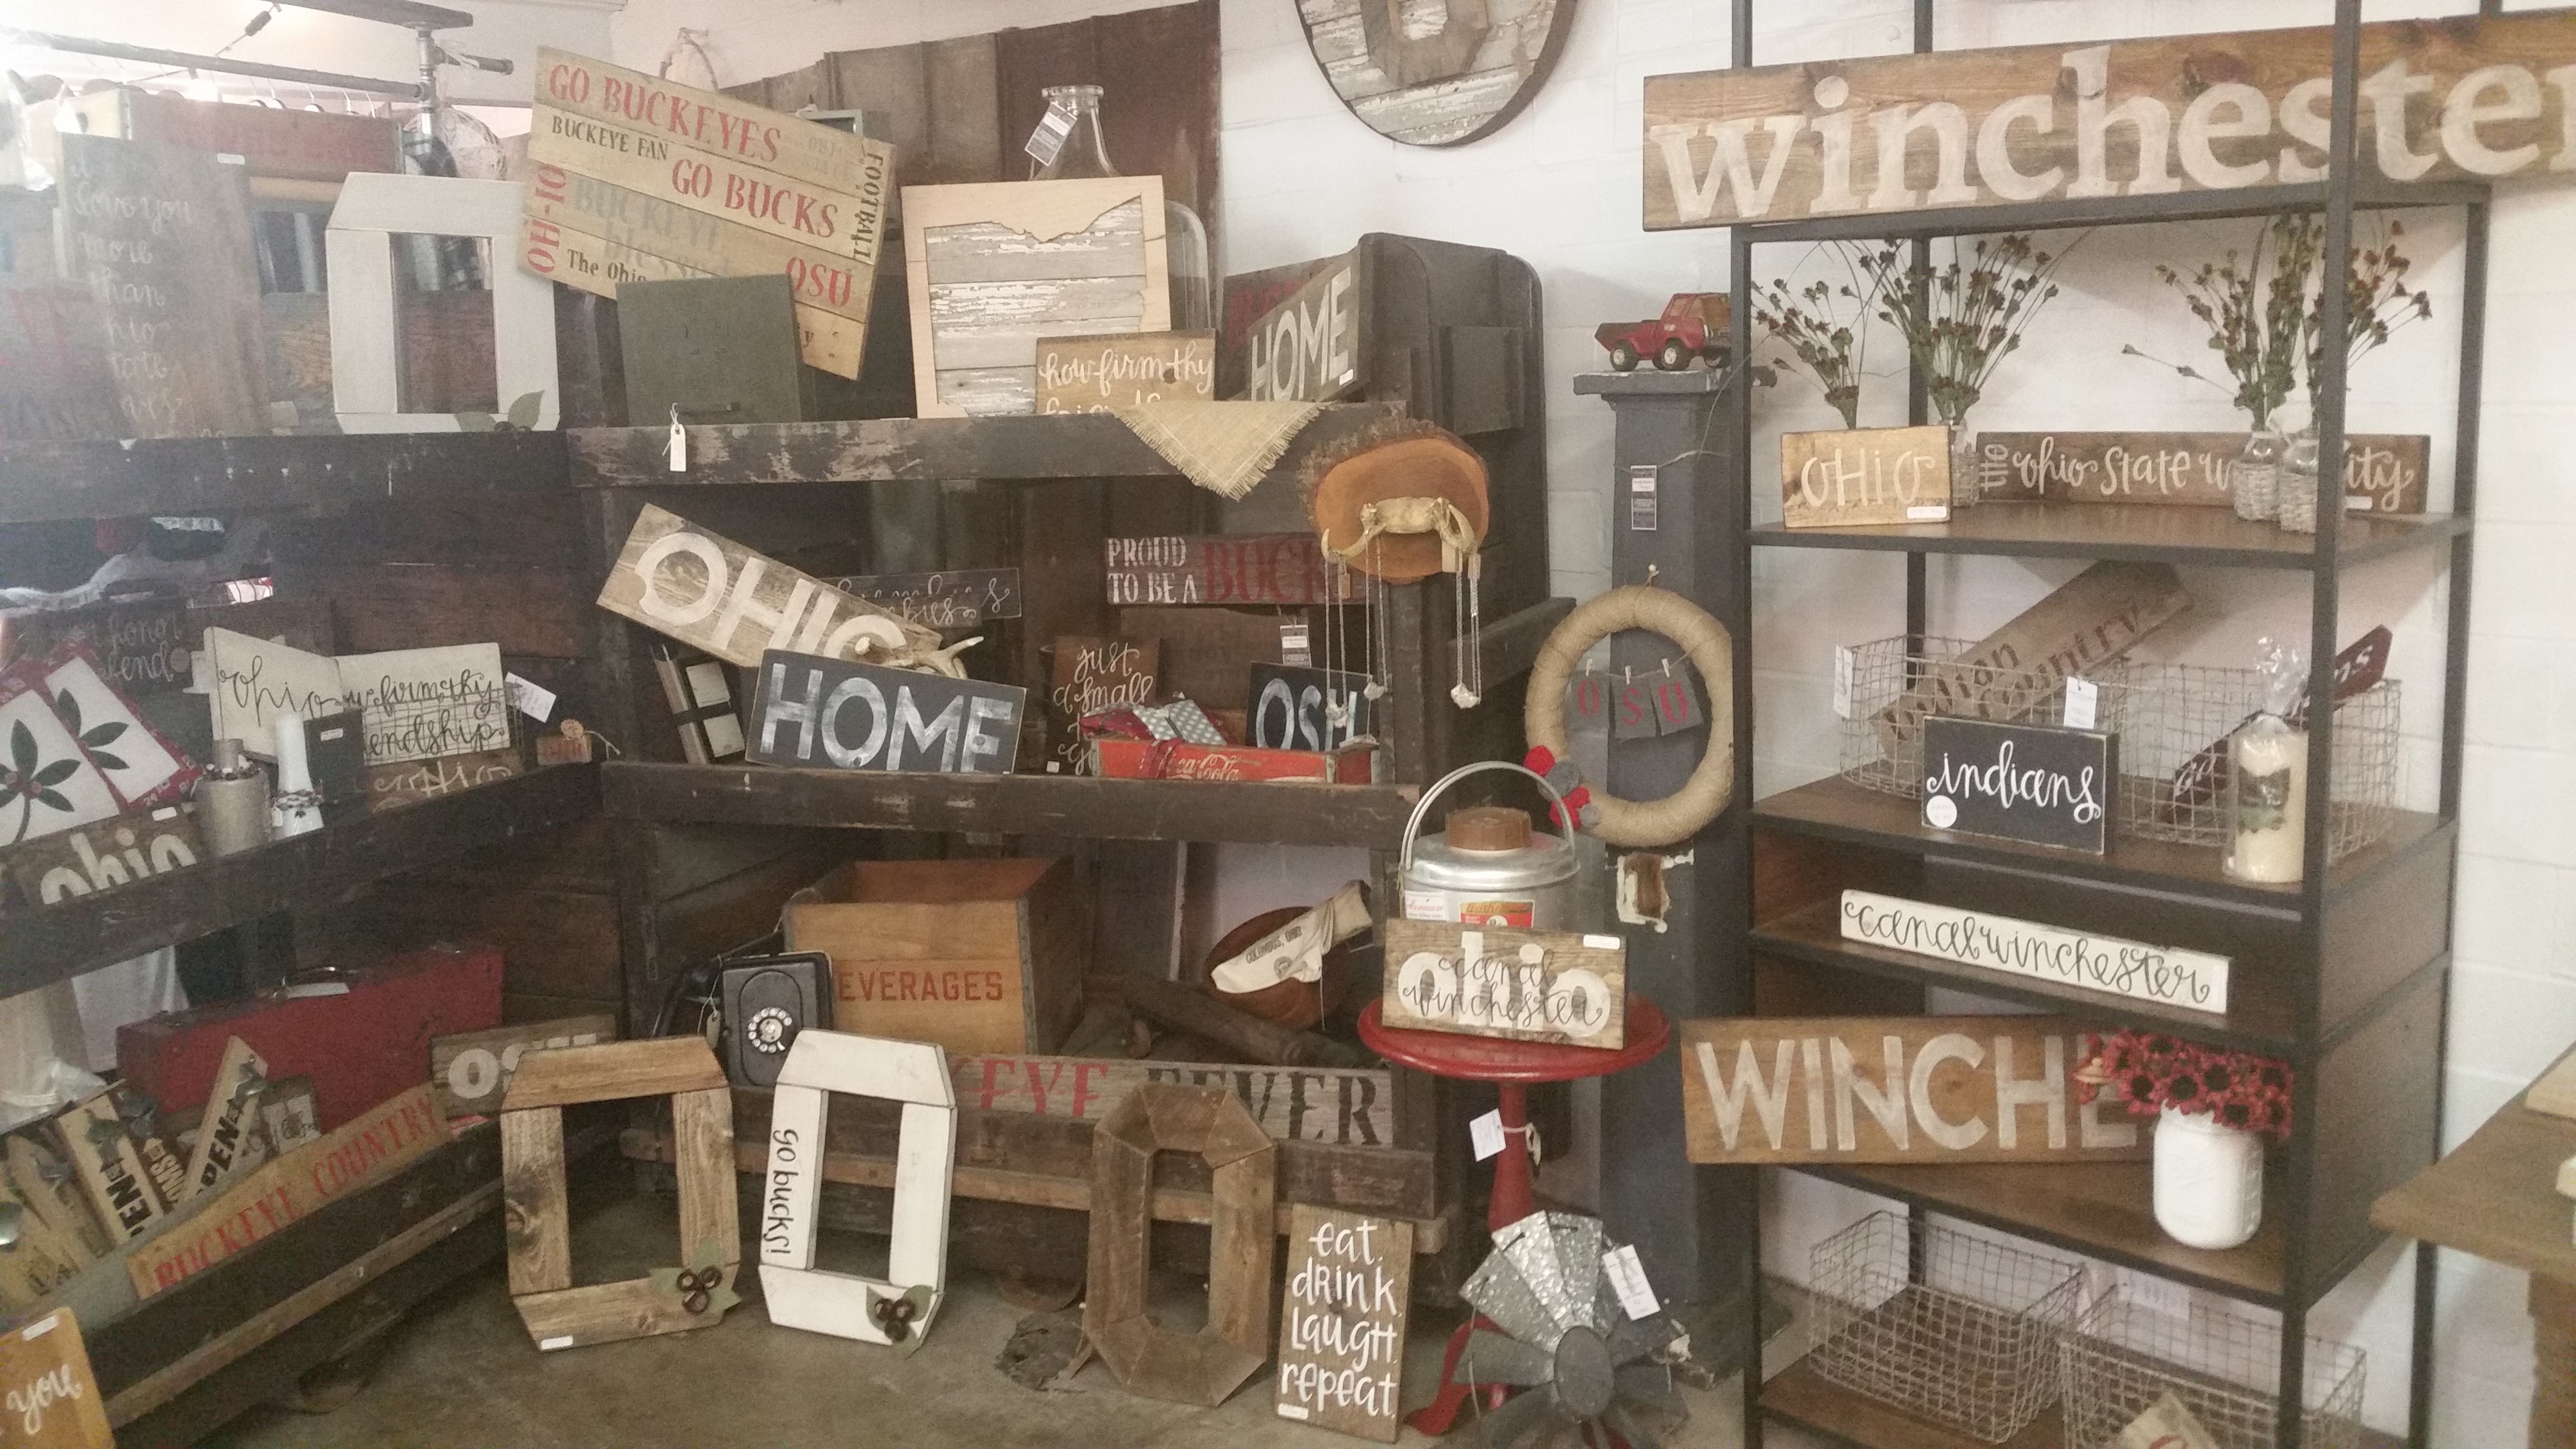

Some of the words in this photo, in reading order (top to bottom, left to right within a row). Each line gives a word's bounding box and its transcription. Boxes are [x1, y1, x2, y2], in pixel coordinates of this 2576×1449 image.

[549, 63, 589, 102] GO
[604, 76, 781, 163] BUCKEYES
[551, 115, 628, 153] BUCKEYE
[637, 137, 670, 161] FAN
[672, 159, 712, 199] GO
[724, 173, 838, 239] BUCKS
[853, 150, 885, 261] FOOTBALL
[567, 249, 599, 276] The
[785, 256, 853, 308] OSU
[1250, 266, 1352, 401] HOME
[1038, 352, 1097, 389] how
[1093, 348, 1165, 398] firm
[1165, 339, 1213, 395] thy
[1108, 536, 1188, 568] PROUD
[1108, 572, 1139, 604] TO
[1147, 573, 1178, 604] BE
[1182, 573, 1199, 604] A
[1074, 641, 1140, 684] just
[1074, 671, 1154, 713] small
[1578, 679, 1689, 725] OSU
[759, 662, 1014, 775] HOME
[1926, 739, 2102, 824] indians
[837, 970, 1004, 1002] EVERAGES
[772, 1128, 799, 1163] go
[764, 1169, 800, 1256] bucks!
[6, 1363, 83, 1435] you
